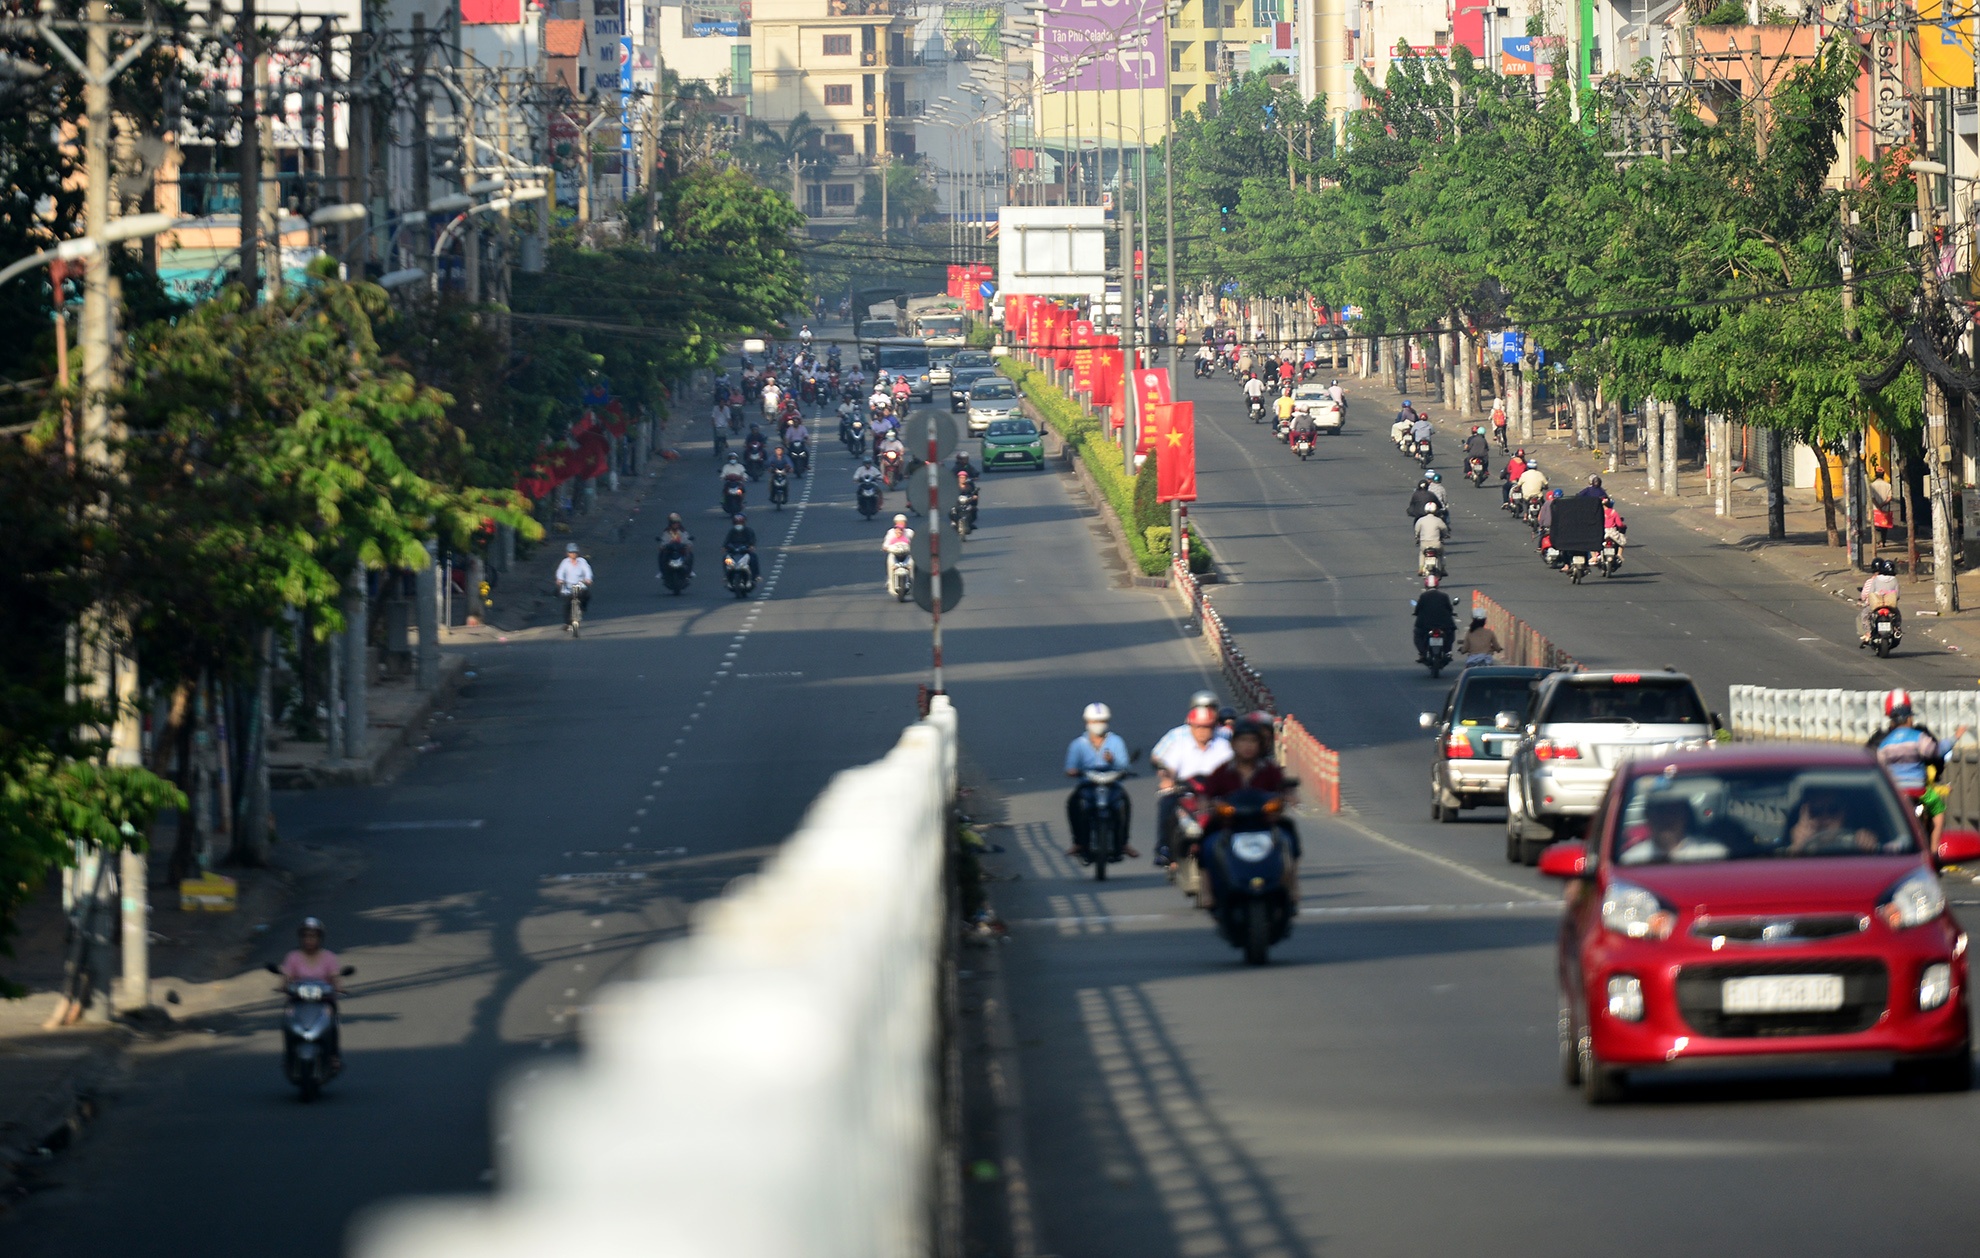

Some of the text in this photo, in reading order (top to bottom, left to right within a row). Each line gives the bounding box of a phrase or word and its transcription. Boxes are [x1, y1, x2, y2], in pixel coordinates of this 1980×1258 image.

[595, 19, 619, 34] DNTN
[1052, 29, 1067, 42] Tân
[1084, 28, 1113, 41] Celadon
[1515, 44, 1531, 52] VIB
[1505, 63, 1526, 72] ATM
[1878, 45, 1899, 81] SÀI
